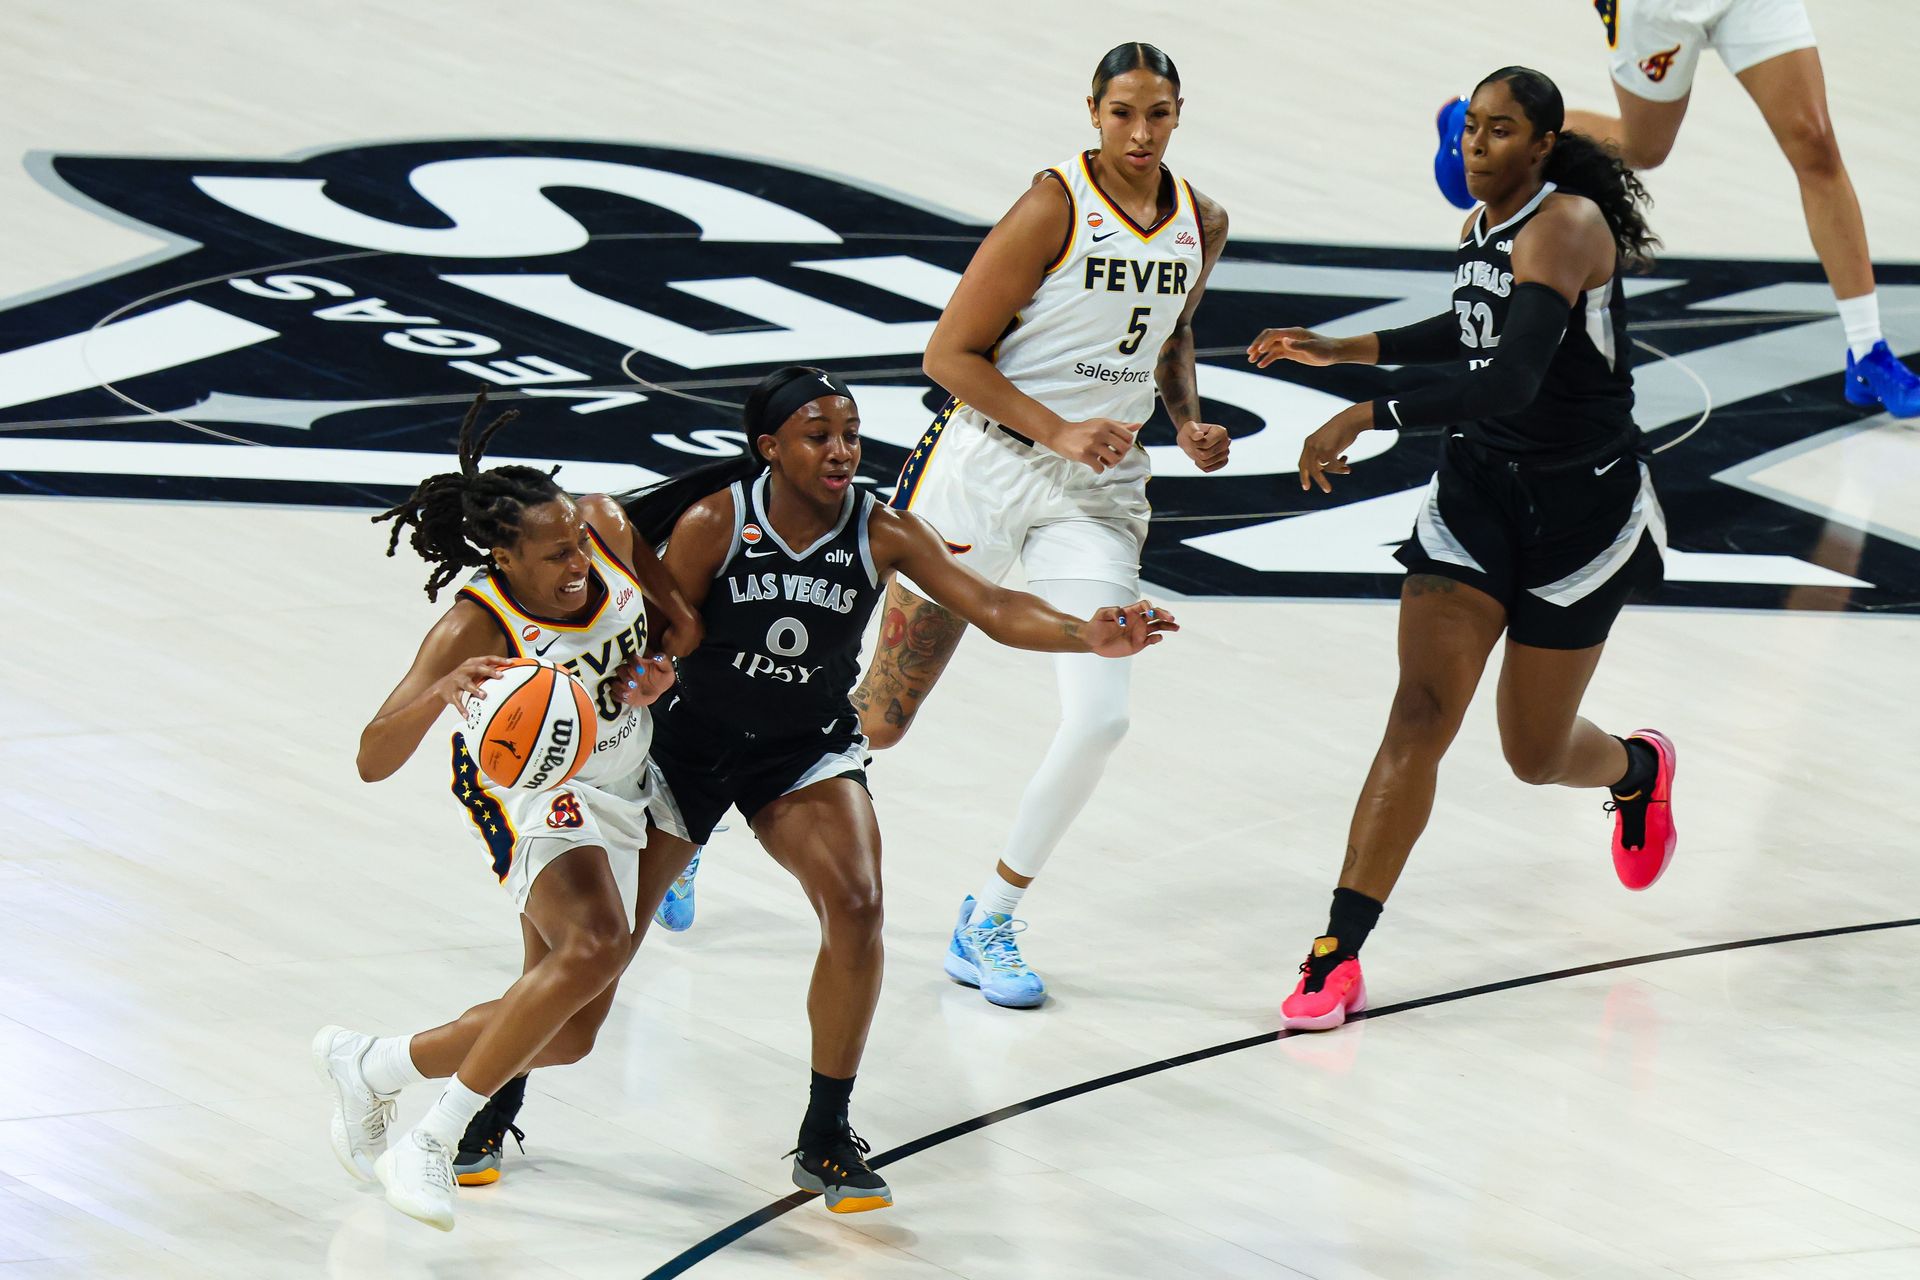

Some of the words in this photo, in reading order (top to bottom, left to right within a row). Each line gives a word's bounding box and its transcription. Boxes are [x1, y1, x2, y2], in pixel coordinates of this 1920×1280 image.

[1175, 231, 1197, 249] Lilly
[1084, 256, 1188, 295] FEVER
[229, 274, 648, 414] VEGAS
[1118, 306, 1151, 355] 5
[1454, 300, 1502, 349] 32
[1073, 361, 1150, 386] salesforce
[825, 549, 854, 567] ally
[616, 587, 634, 611] Lilly
[728, 572, 778, 604] LAS
[782, 573, 858, 614] VEGAS
[765, 616, 809, 658] 0
[731, 651, 824, 684] IPSY
[524, 717, 574, 789] Wilson
